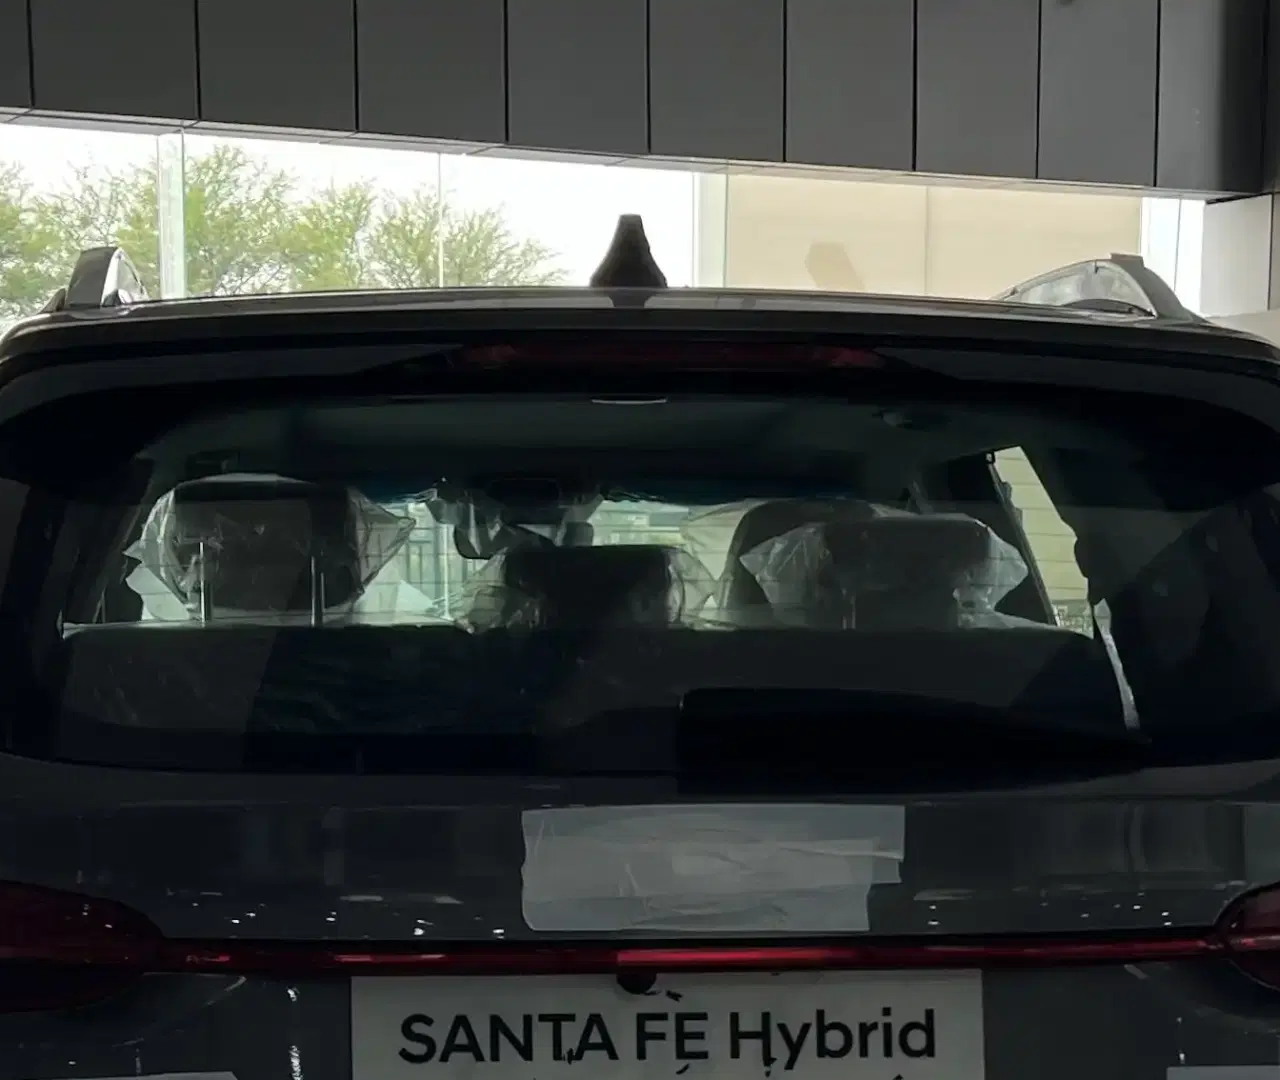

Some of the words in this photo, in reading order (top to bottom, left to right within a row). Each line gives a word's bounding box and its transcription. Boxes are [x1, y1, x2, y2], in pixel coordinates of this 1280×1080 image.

[398, 1012, 619, 1064] SANTA
[636, 1012, 709, 1061] FE
[729, 1006, 936, 1071] Hybrid
